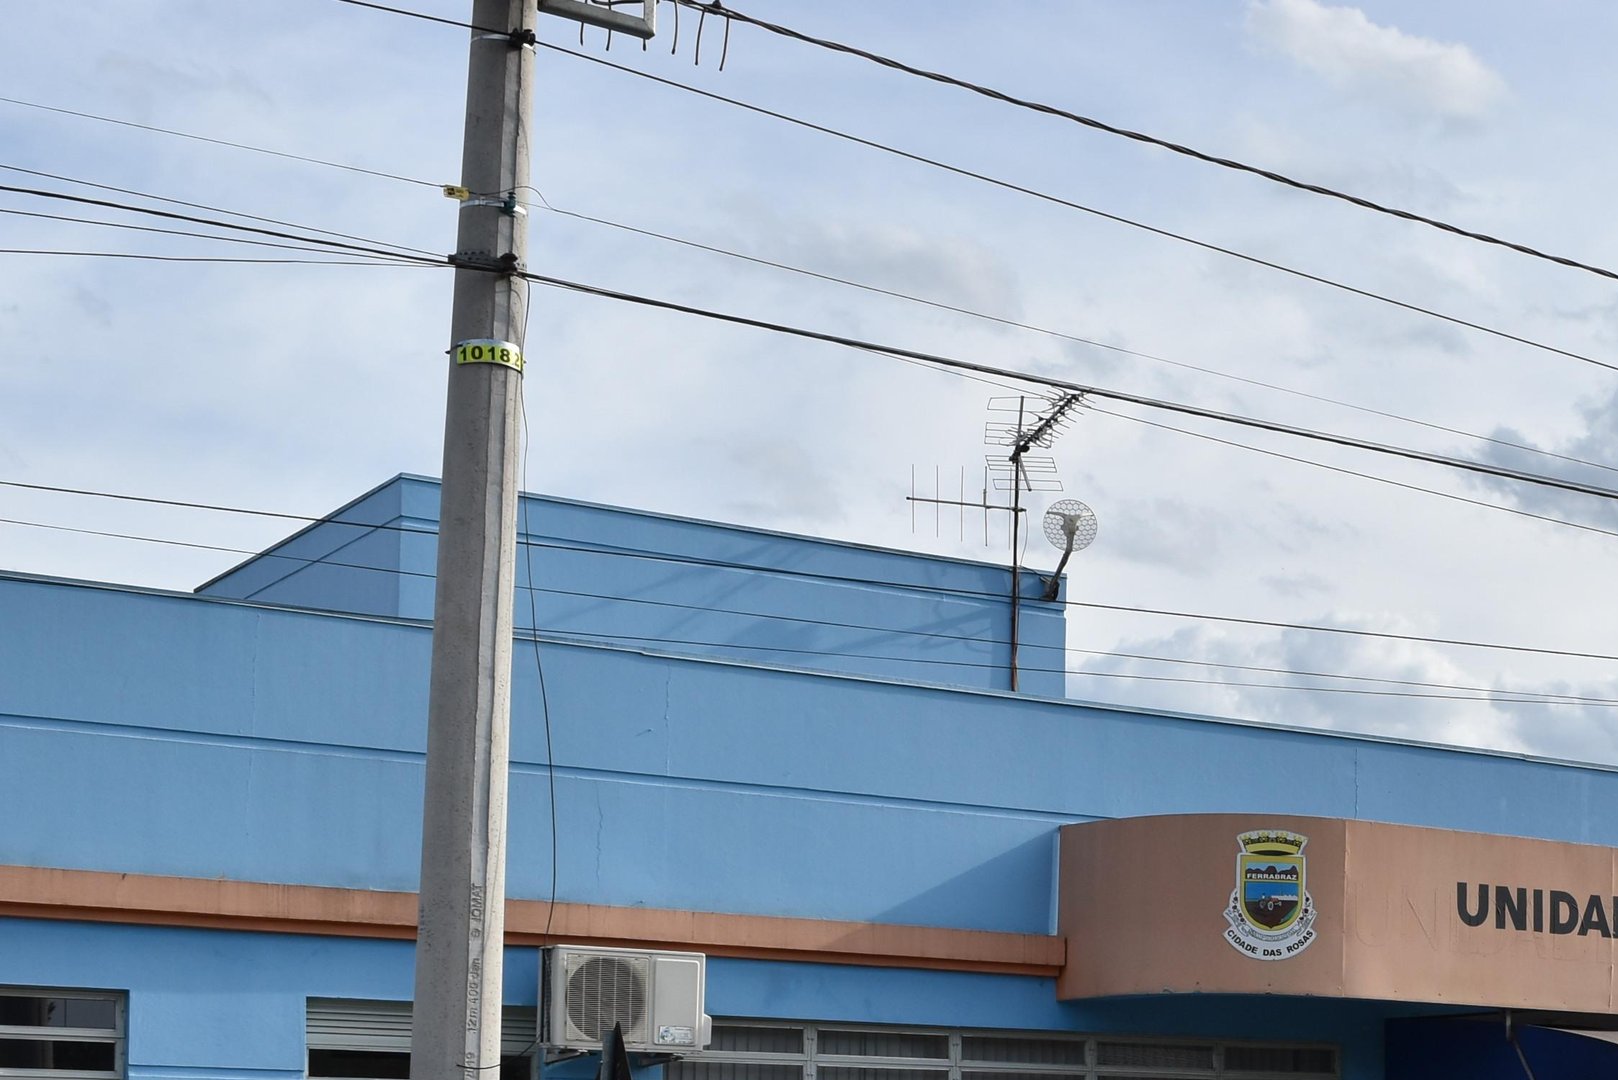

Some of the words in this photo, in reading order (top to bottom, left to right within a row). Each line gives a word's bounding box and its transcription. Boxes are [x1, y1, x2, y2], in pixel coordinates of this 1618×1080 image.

[1246, 873, 1297, 881] FERRABRAZ
[1227, 929, 1258, 954] CIDADE
[1262, 948, 1283, 957] DAS
[1286, 930, 1314, 953] ROSAS
